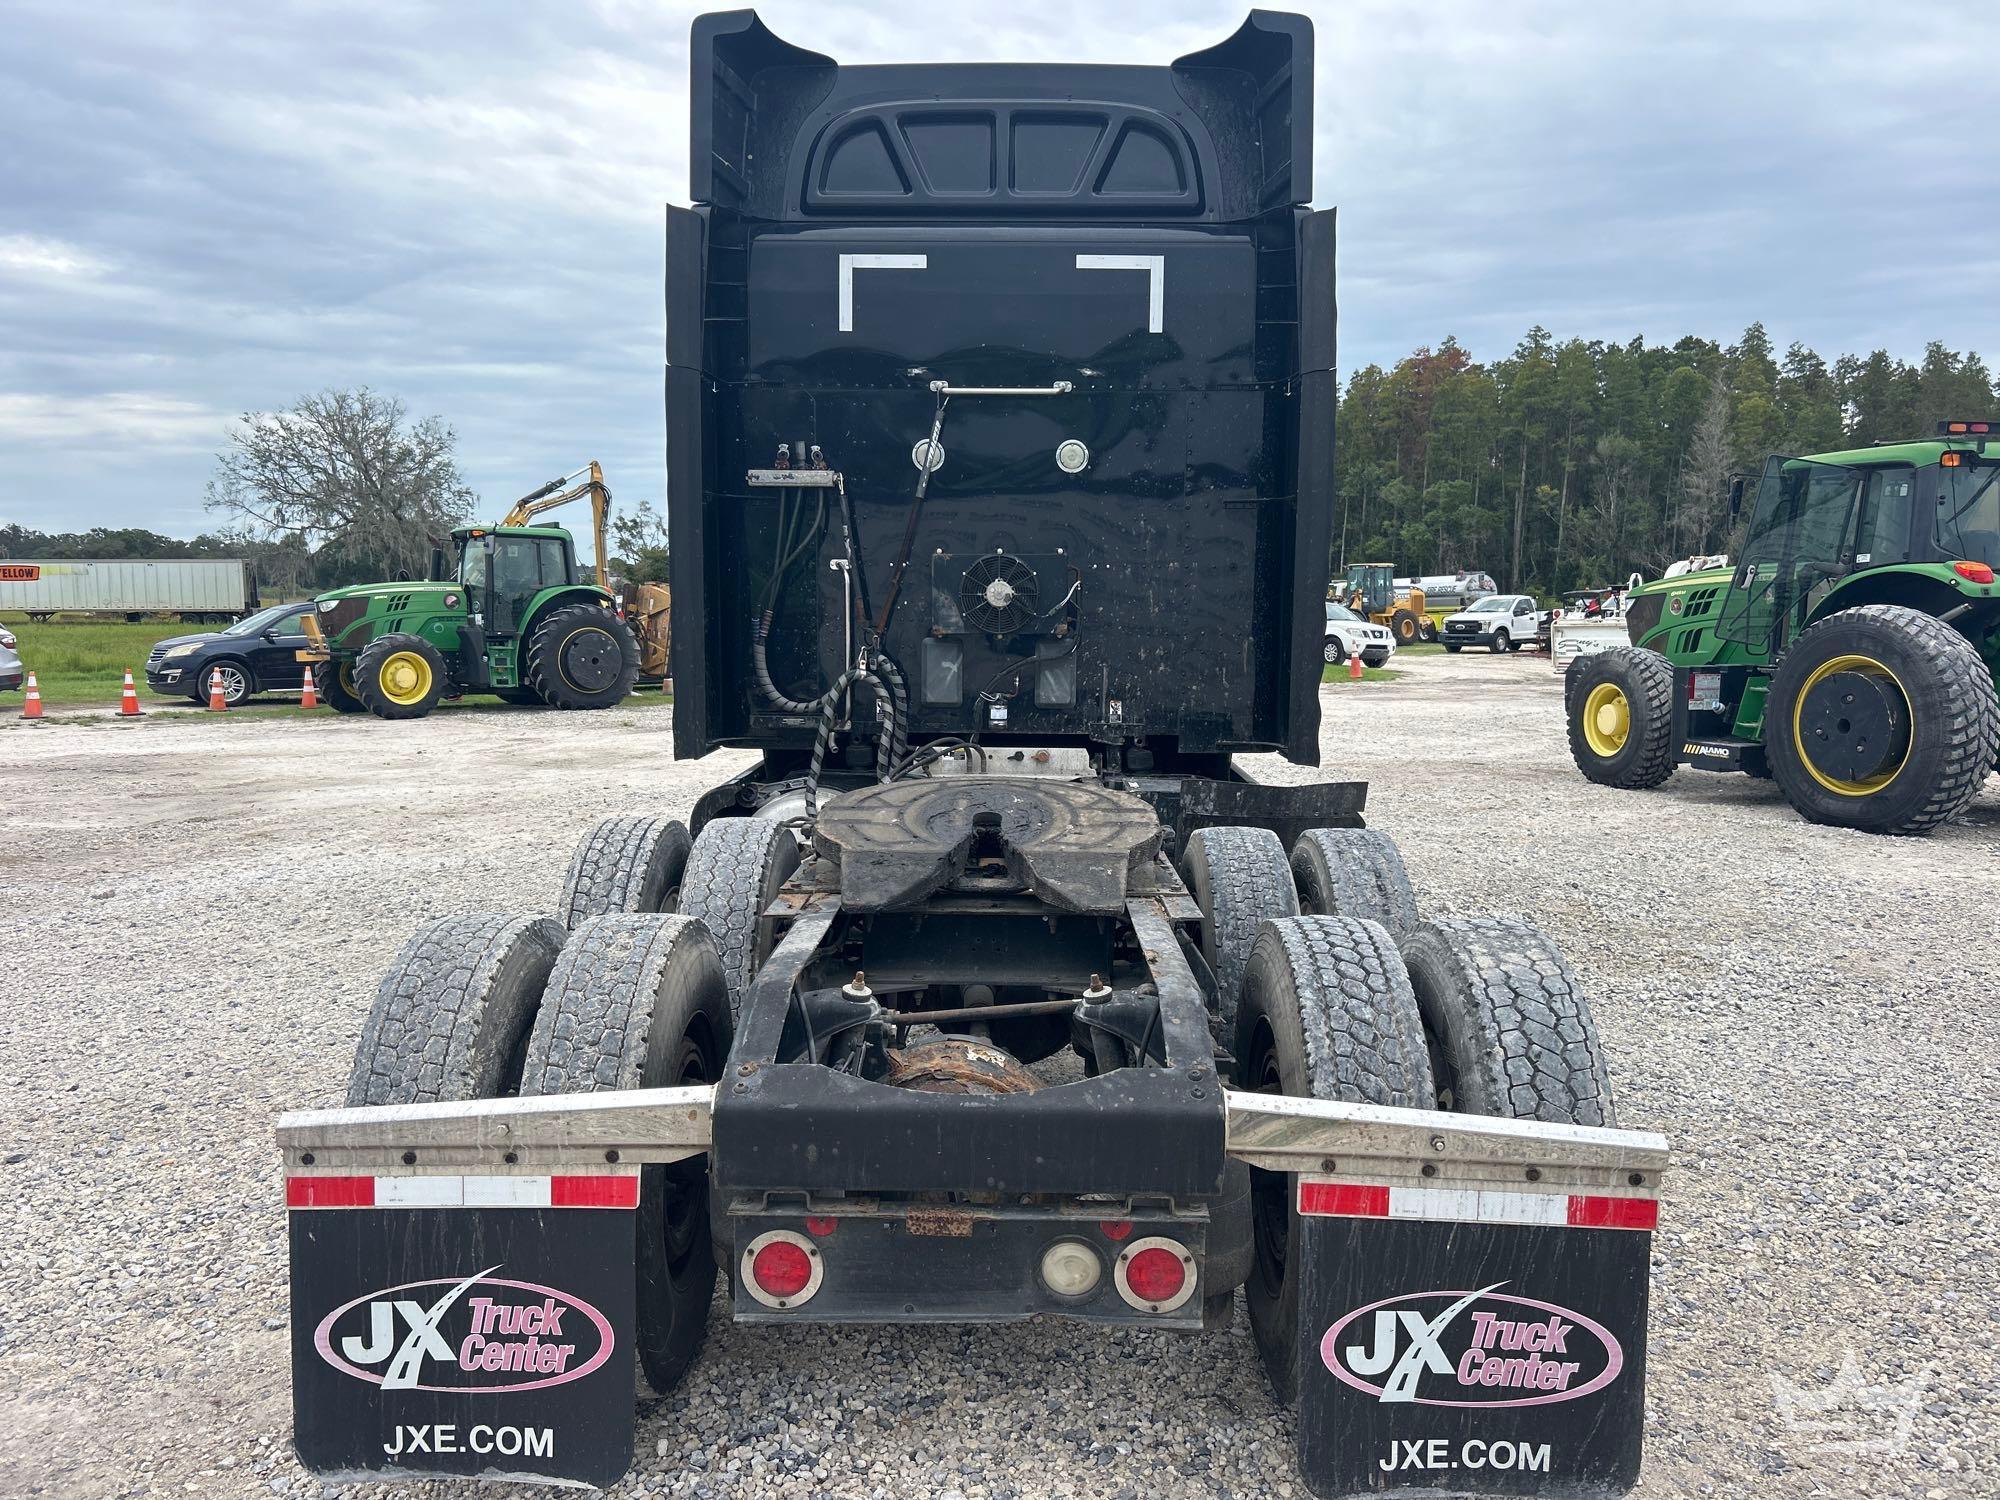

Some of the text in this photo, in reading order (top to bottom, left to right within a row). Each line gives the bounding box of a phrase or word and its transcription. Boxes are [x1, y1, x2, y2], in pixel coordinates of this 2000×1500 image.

[0, 568, 34, 578] ELLOW
[1439, 585, 1457, 593] RESCUE
[1698, 746, 1729, 756] ALAMO
[468, 1298, 567, 1336] Truck
[1470, 1312, 1574, 1354] Truck
[342, 1286, 470, 1389] JX
[459, 1335, 575, 1373] Center
[1346, 1298, 1474, 1403] JX
[1457, 1348, 1580, 1391] Center
[383, 1424, 554, 1458] JXE.COM
[1379, 1439, 1551, 1473] JXE.COM
